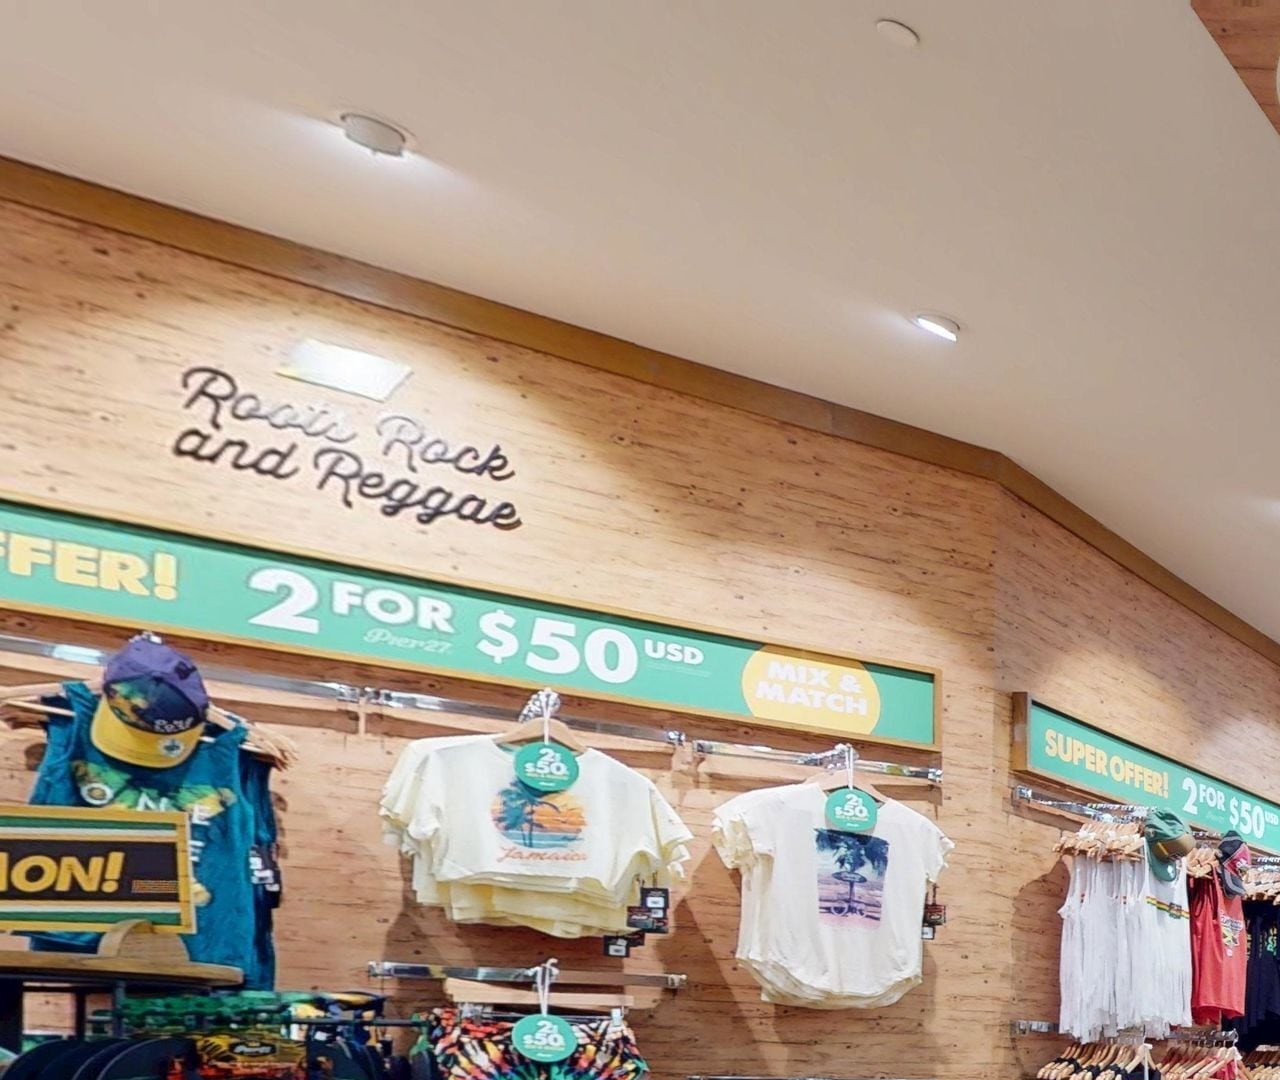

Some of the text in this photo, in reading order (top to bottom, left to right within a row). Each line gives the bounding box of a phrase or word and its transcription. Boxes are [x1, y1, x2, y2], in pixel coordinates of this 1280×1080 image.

[181, 366, 517, 482] Roots Rock
[171, 426, 523, 533] and Reggae
[0, 532, 706, 686] FER! 2 FOR $50 USD
[754, 682, 868, 718] MATCH
[766, 661, 864, 694] MIX &
[1045, 729, 1107, 776] SUPER
[1110, 755, 1169, 799] OFFER!
[1182, 777, 1198, 815] 2
[1199, 784, 1225, 812] FOR
[1229, 797, 1265, 839] $50
[0, 852, 124, 894] ON!
